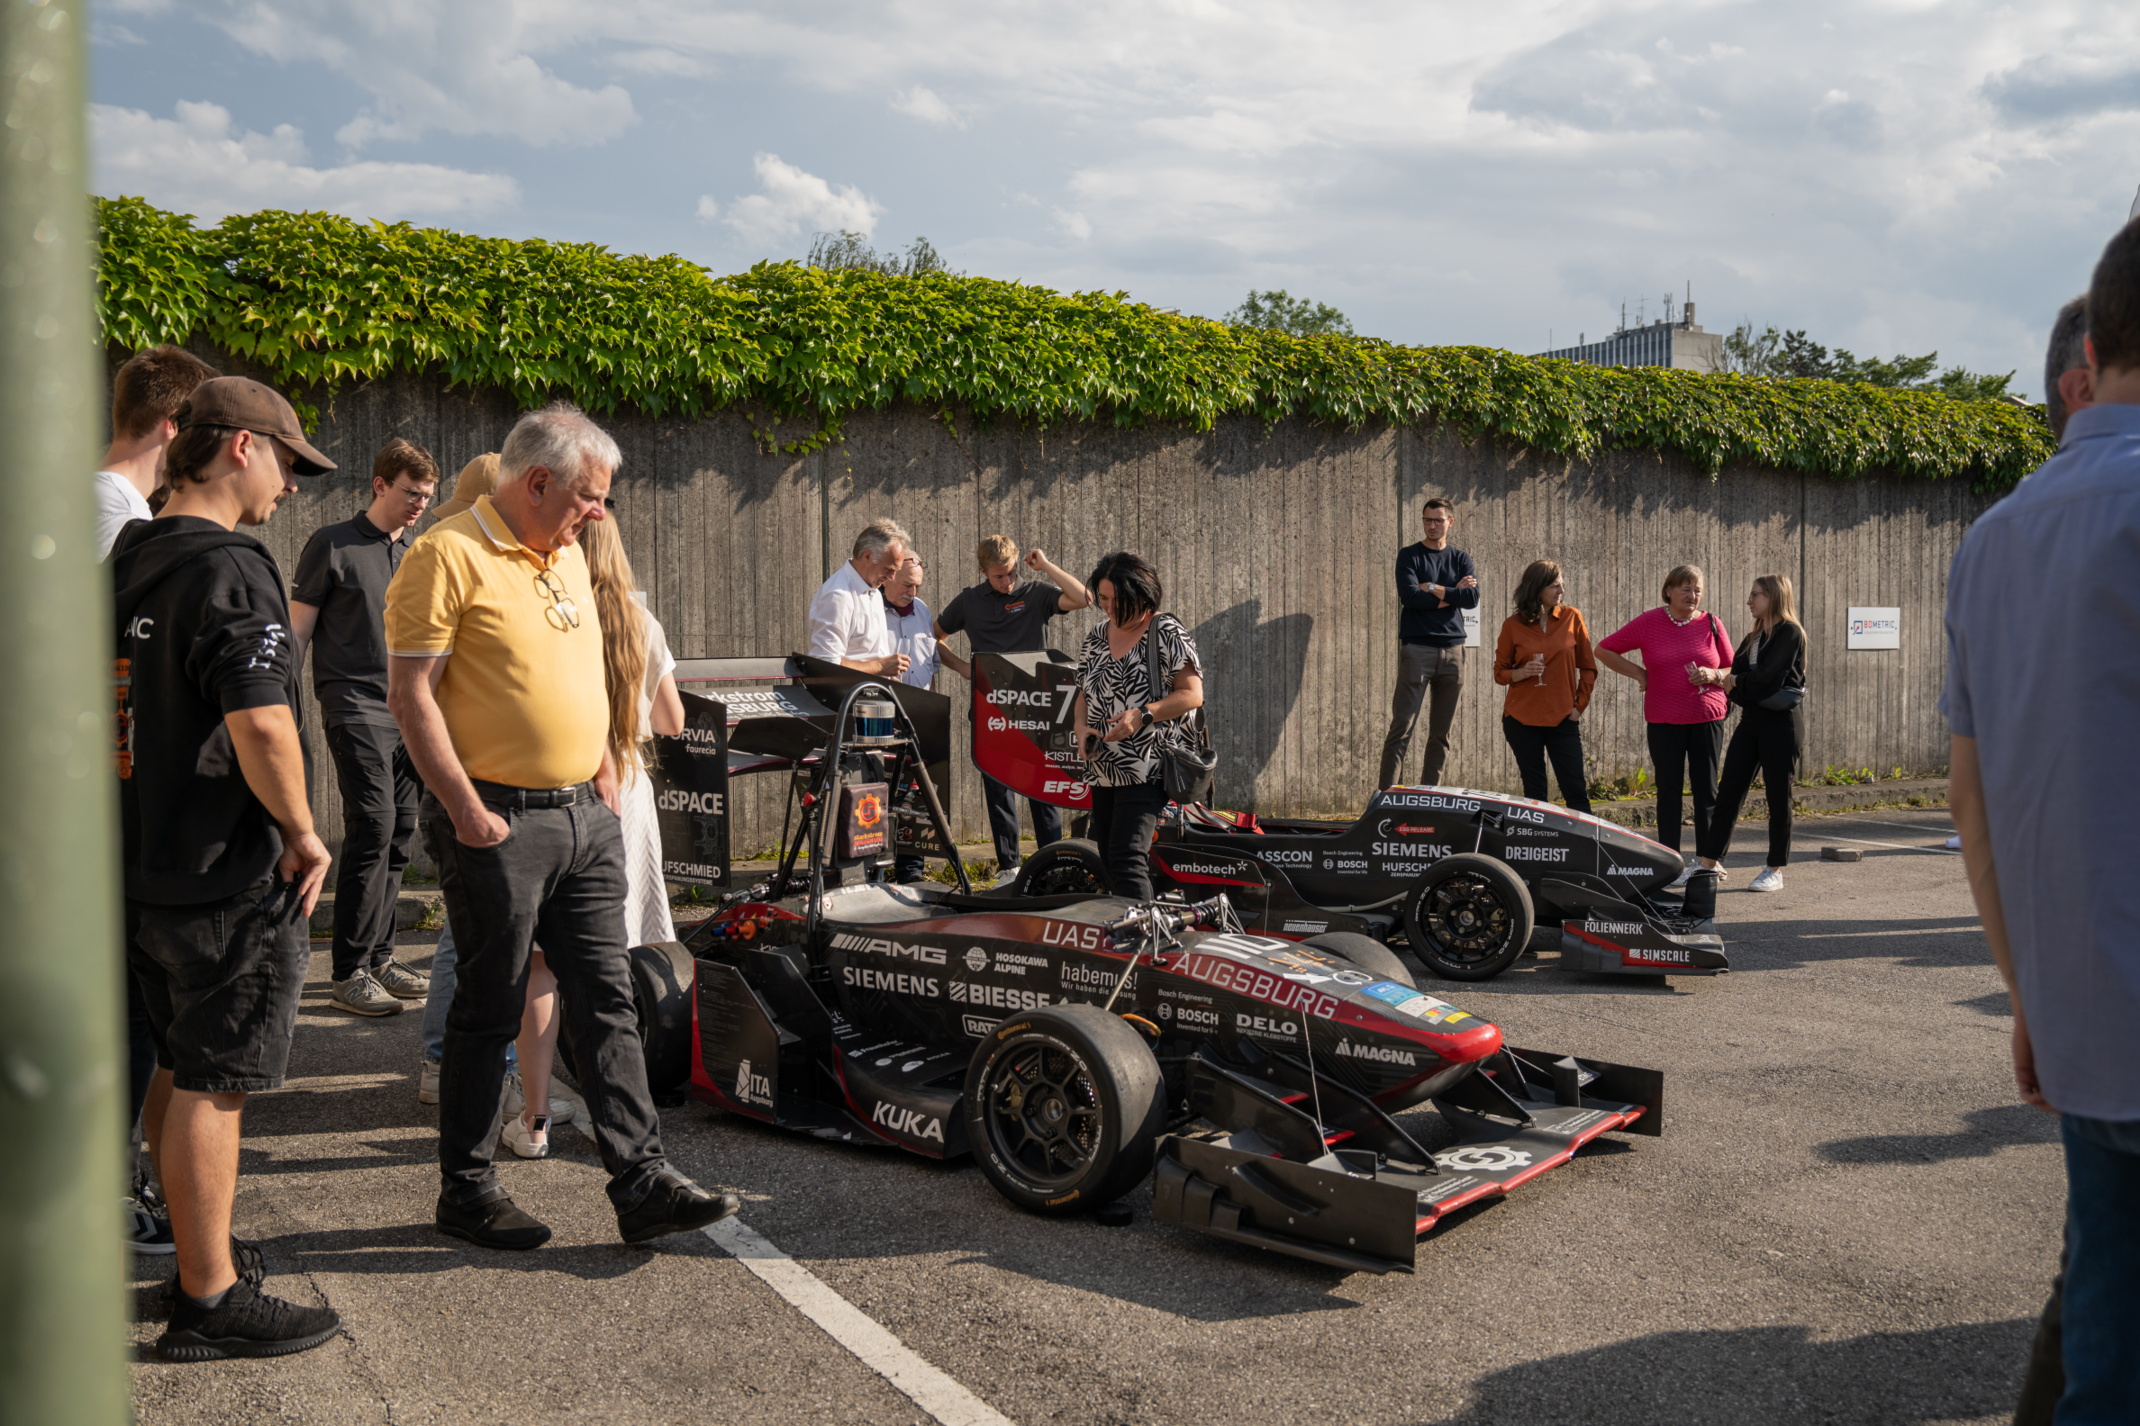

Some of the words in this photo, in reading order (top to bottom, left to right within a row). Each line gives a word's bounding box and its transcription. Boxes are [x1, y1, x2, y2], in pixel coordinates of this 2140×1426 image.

[698, 691, 786, 703] rkstrom
[986, 689, 1051, 707] dSPACE
[1055, 684, 1077, 724] 7
[727, 701, 798, 712] SBURG
[1008, 719, 1050, 731] HESAI
[685, 744, 716, 755] faurecia
[1043, 781, 1085, 795] EFS
[658, 789, 724, 815] dSPACE
[1381, 795, 1481, 812] AUGSBURG
[1508, 806, 1545, 824] UAS
[1517, 827, 1533, 836] SBG
[914, 841, 940, 851] CURE
[1372, 842, 1452, 858] SIEMENS
[1257, 850, 1313, 862] ASSCON
[1173, 862, 1236, 875] embotech
[1337, 860, 1368, 869] BOSCH
[1382, 862, 1431, 872] HUFSCH
[1617, 867, 1654, 876] MAGNA
[1043, 921, 1100, 950] UAS
[864, 938, 947, 965] AMG
[1642, 949, 1690, 962] SIMSCALE
[995, 952, 1049, 968] HOSOKAWA
[994, 964, 1026, 976] ALPINE
[843, 966, 939, 998] SIEMENS
[1061, 980, 1074, 990] Wir
[1075, 982, 1097, 993] haben
[1098, 987, 1110, 996] die
[1171, 952, 1339, 1020] AUGSBURG
[969, 983, 1050, 1011] BIESSE
[1158, 988, 1176, 998] Bosch
[1178, 990, 1213, 1004] Engineering
[1177, 1007, 1219, 1026] BOSCH
[1236, 1013, 1298, 1036] DELO
[1263, 1031, 1297, 1043] KLEBSTOFFE
[1353, 1043, 1417, 1067] MAGNA
[750, 1073, 771, 1098] ITA
[750, 1093, 774, 1108] Augsburg
[872, 1100, 945, 1144] KUKA
